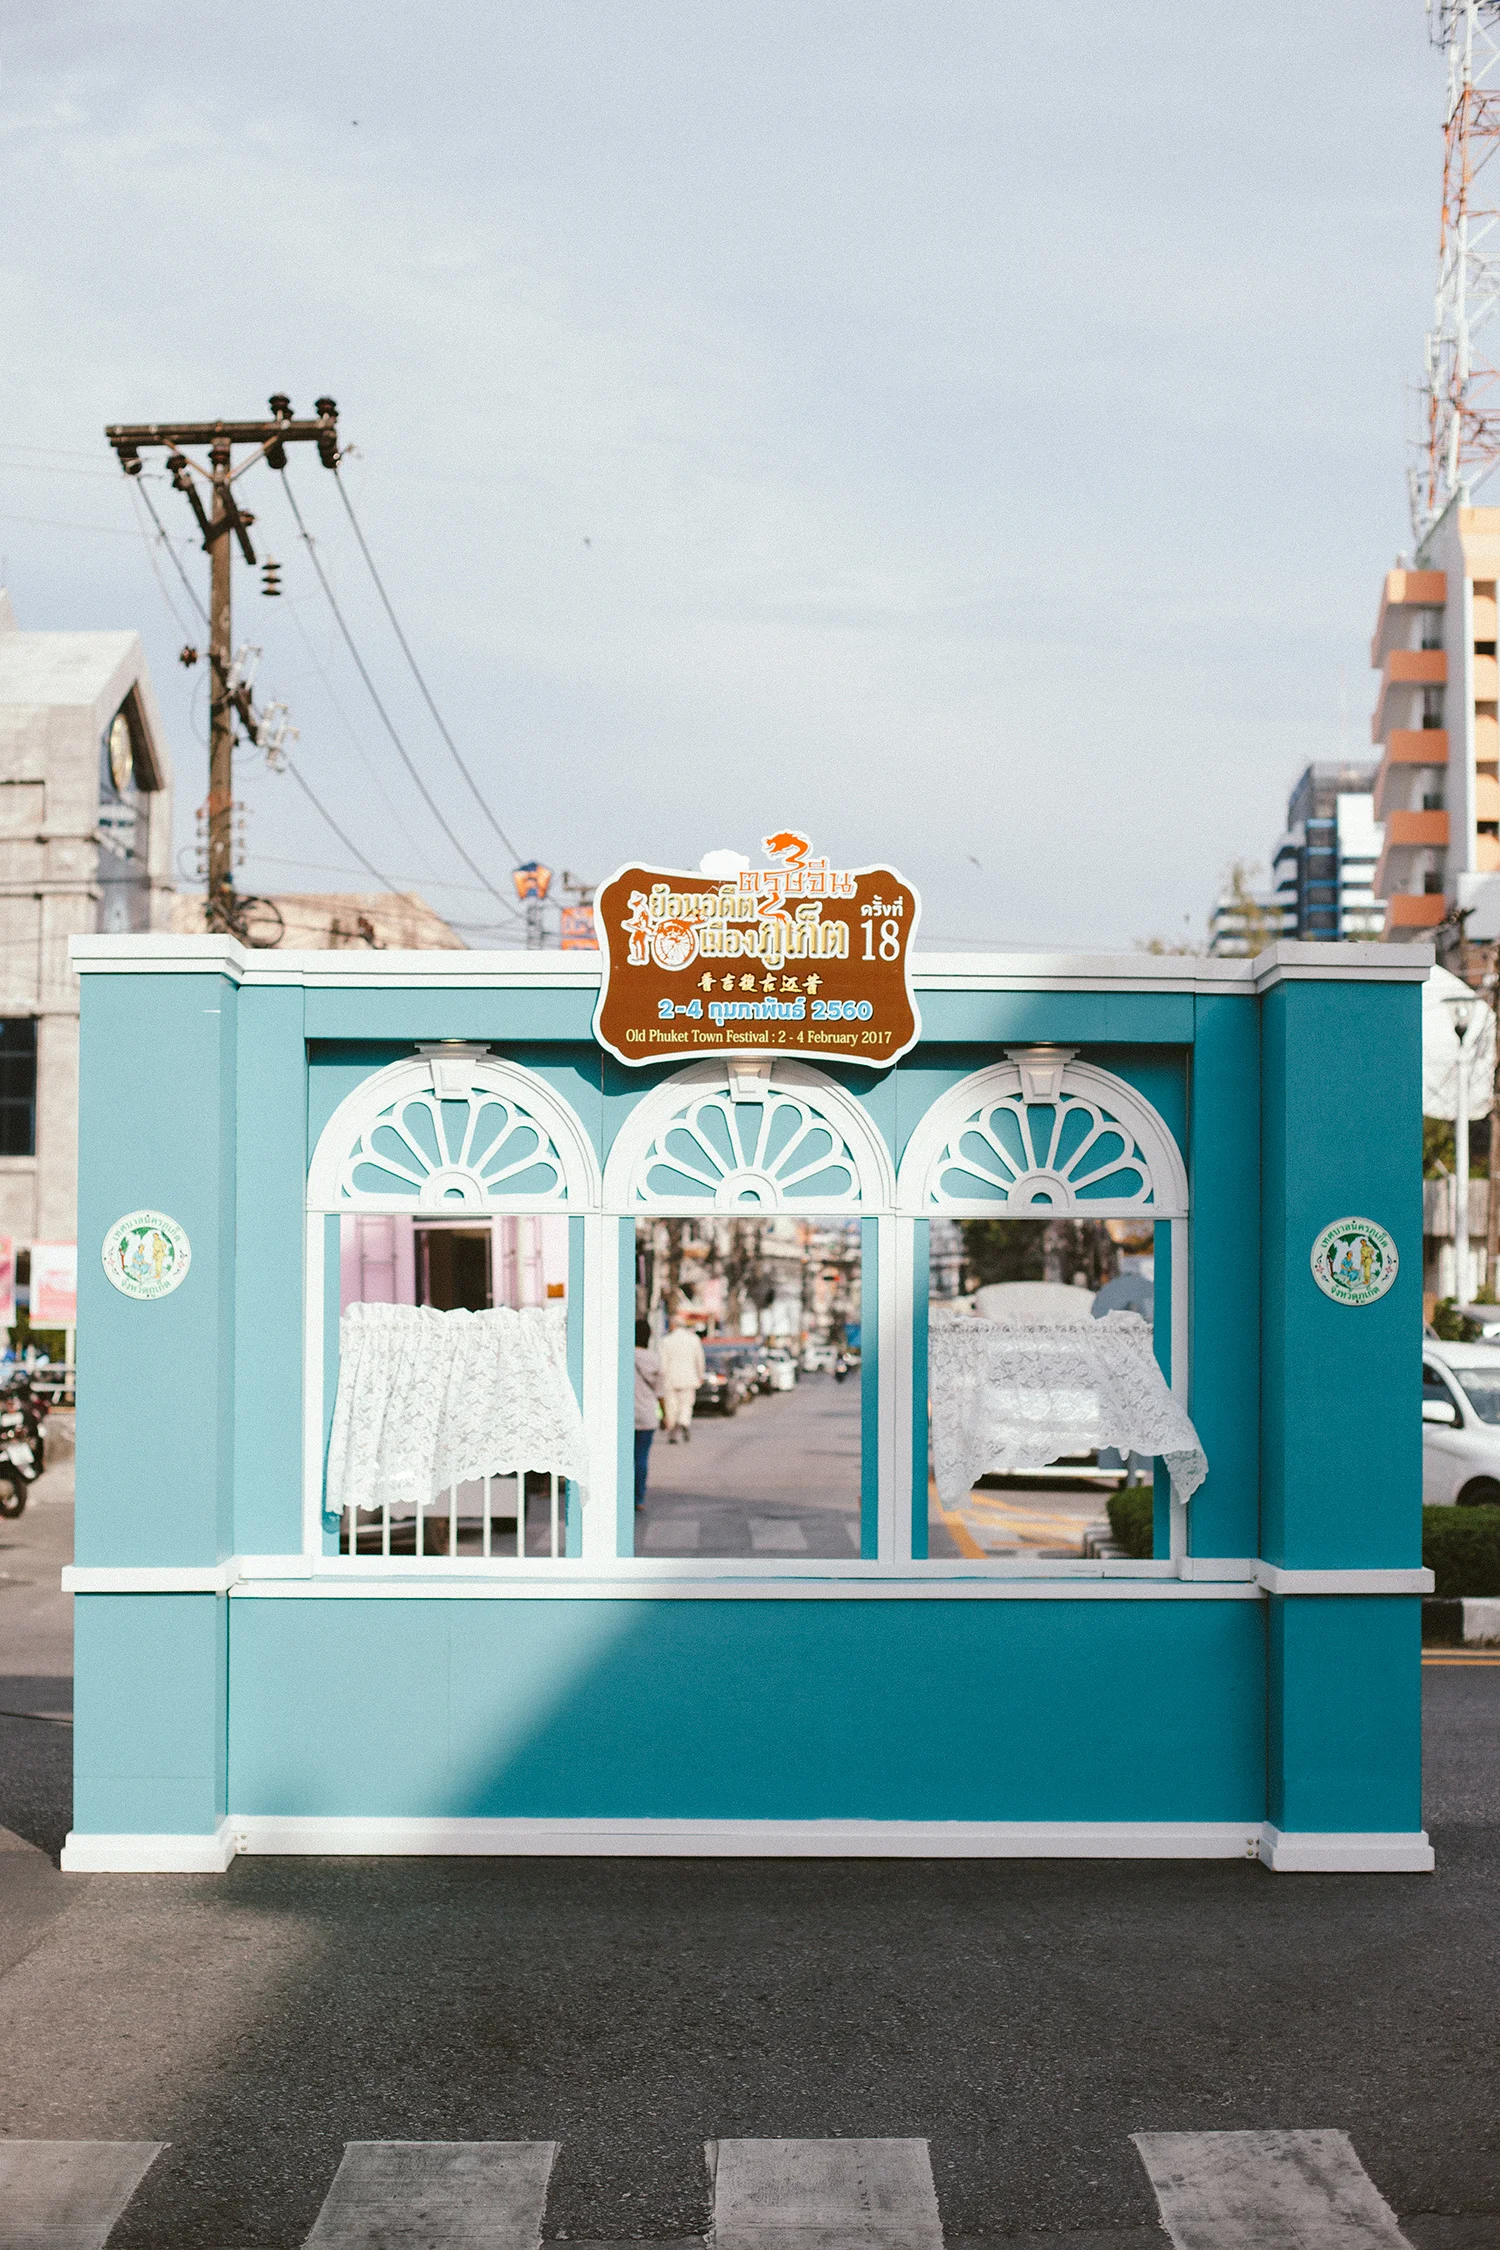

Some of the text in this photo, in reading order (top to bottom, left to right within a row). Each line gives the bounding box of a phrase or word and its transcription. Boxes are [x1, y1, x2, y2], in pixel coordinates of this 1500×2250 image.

[861, 894, 903, 917] ครั้งที่
[861, 919, 901, 962] 18
[658, 996, 873, 1027] 2-4 กุมภาพันธ์ 2560
[625, 1029, 646, 1042] Old
[649, 1029, 689, 1043] Phuket
[691, 1029, 723, 1043] Town
[726, 1029, 769, 1043] Festival
[778, 1031, 786, 1043] 2
[797, 1032, 804, 1043] 4
[807, 1031, 858, 1047] February
[861, 1031, 892, 1044] 2017
